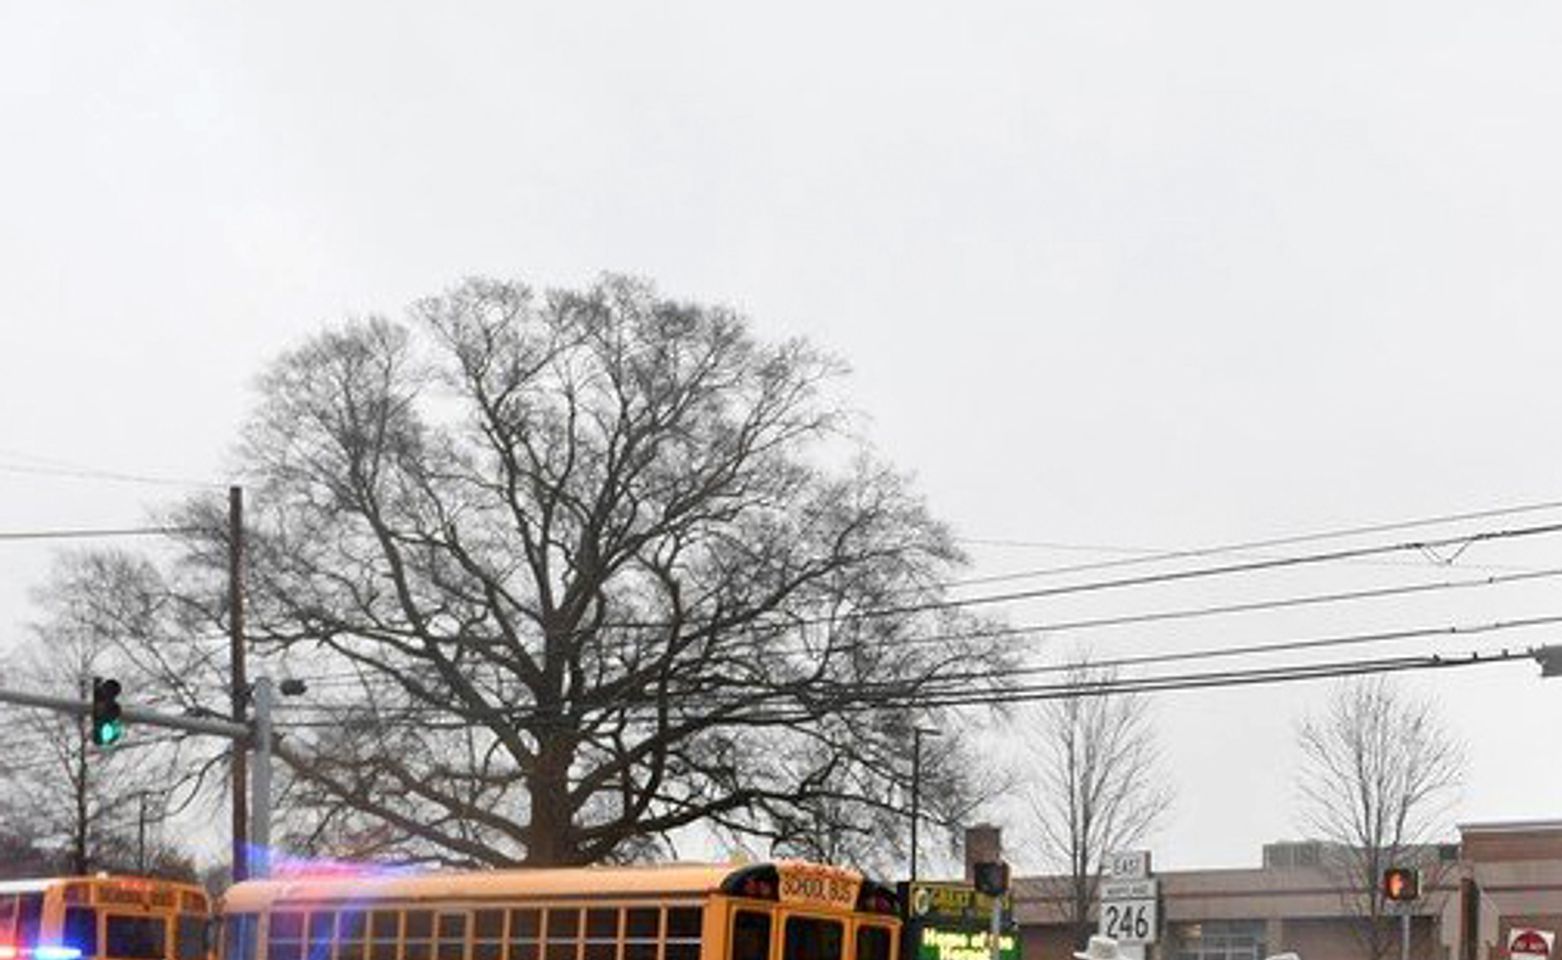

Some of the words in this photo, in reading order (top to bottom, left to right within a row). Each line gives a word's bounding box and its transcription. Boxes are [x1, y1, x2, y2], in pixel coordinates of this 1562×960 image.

[1113, 857, 1141, 876] EAST
[783, 879, 826, 901] SCHOOL
[830, 880, 854, 903] BUS
[1106, 905, 1149, 938] 246
[923, 927, 968, 948] Home
